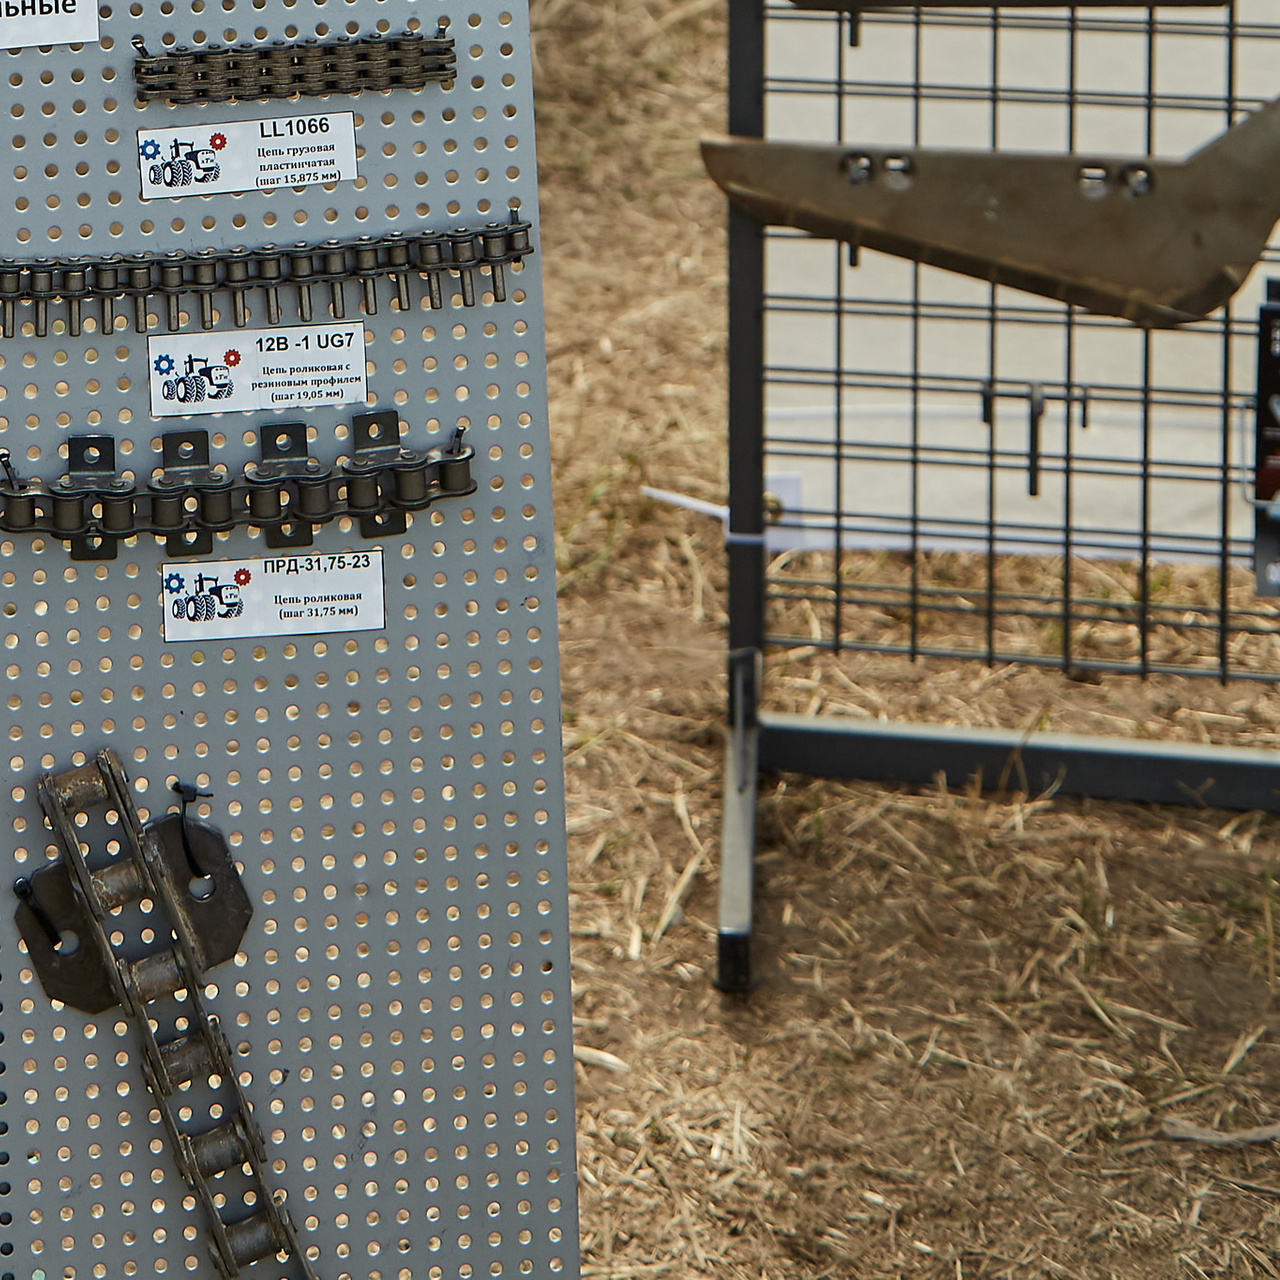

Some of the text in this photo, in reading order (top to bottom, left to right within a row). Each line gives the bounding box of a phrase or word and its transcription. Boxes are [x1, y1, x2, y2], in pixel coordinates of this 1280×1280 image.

[260, 117, 330, 138] LL1066
[257, 144, 335, 158] Цепь грузовая
[259, 159, 335, 172] пластинчатая
[255, 170, 342, 188] (шаг 15,875 мм)
[317, 332, 354, 349] UG7
[262, 366, 287, 376] Цепь
[289, 364, 343, 376] роликовая
[251, 376, 361, 391] резиновым профилем
[271, 388, 344, 403] (шаг 19,05 мм)
[264, 554, 370, 575] ПРД-31,75-23
[274, 593, 362, 606] Цепь роликовая
[279, 605, 358, 620] (шаг 31,75 мм)
